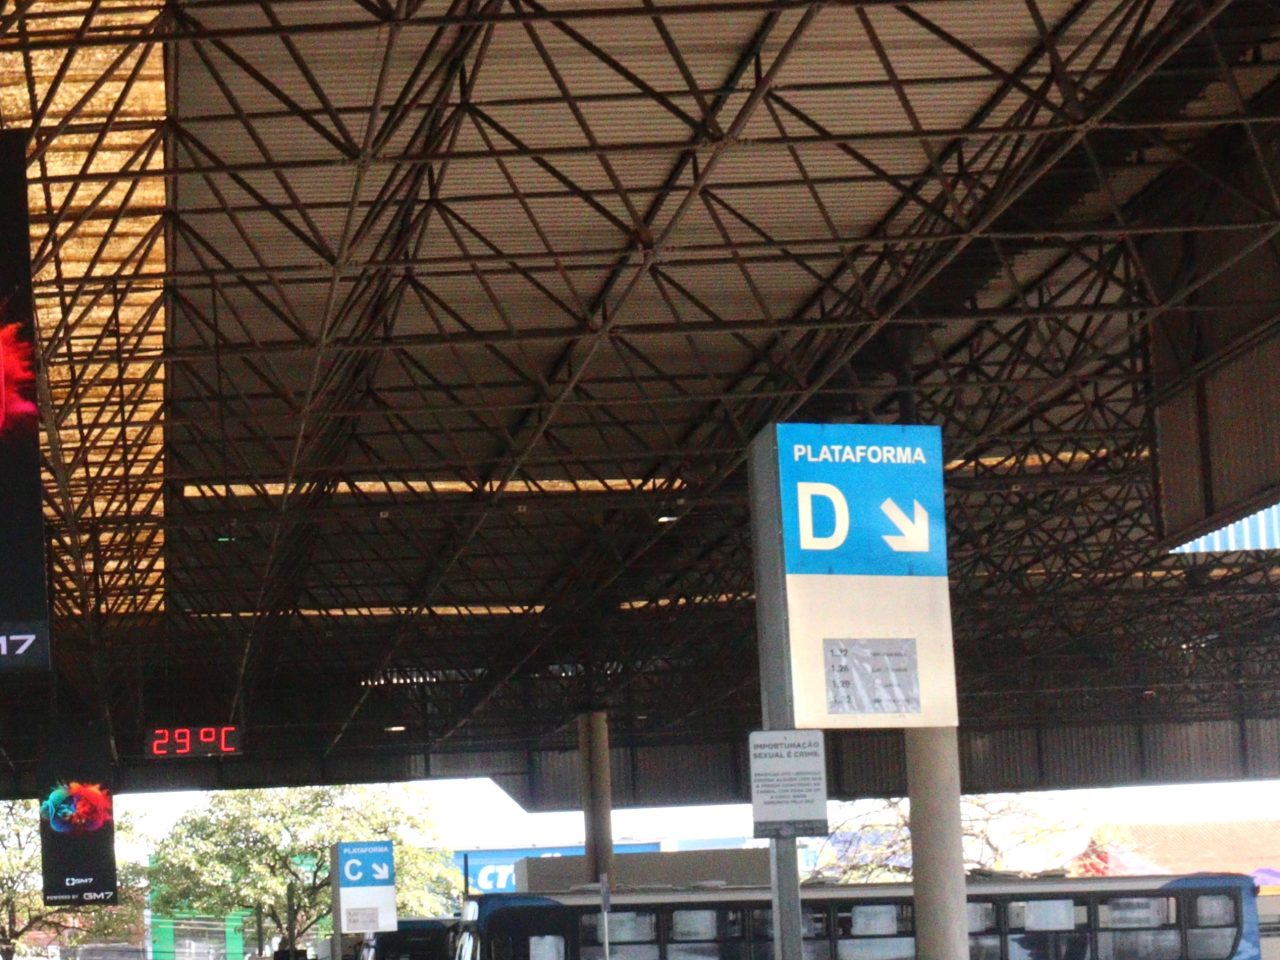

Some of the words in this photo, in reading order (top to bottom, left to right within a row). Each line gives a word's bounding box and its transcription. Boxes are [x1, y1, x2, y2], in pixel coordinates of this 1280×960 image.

[793, 444, 927, 465] PLATAFORMA
[797, 481, 850, 550] D
[753, 751, 785, 760] SEXUAL
[343, 846, 389, 855] PLATAFORMA
[343, 858, 363, 881] C
[477, 864, 517, 890] CT
[83, 891, 114, 900] GM7
